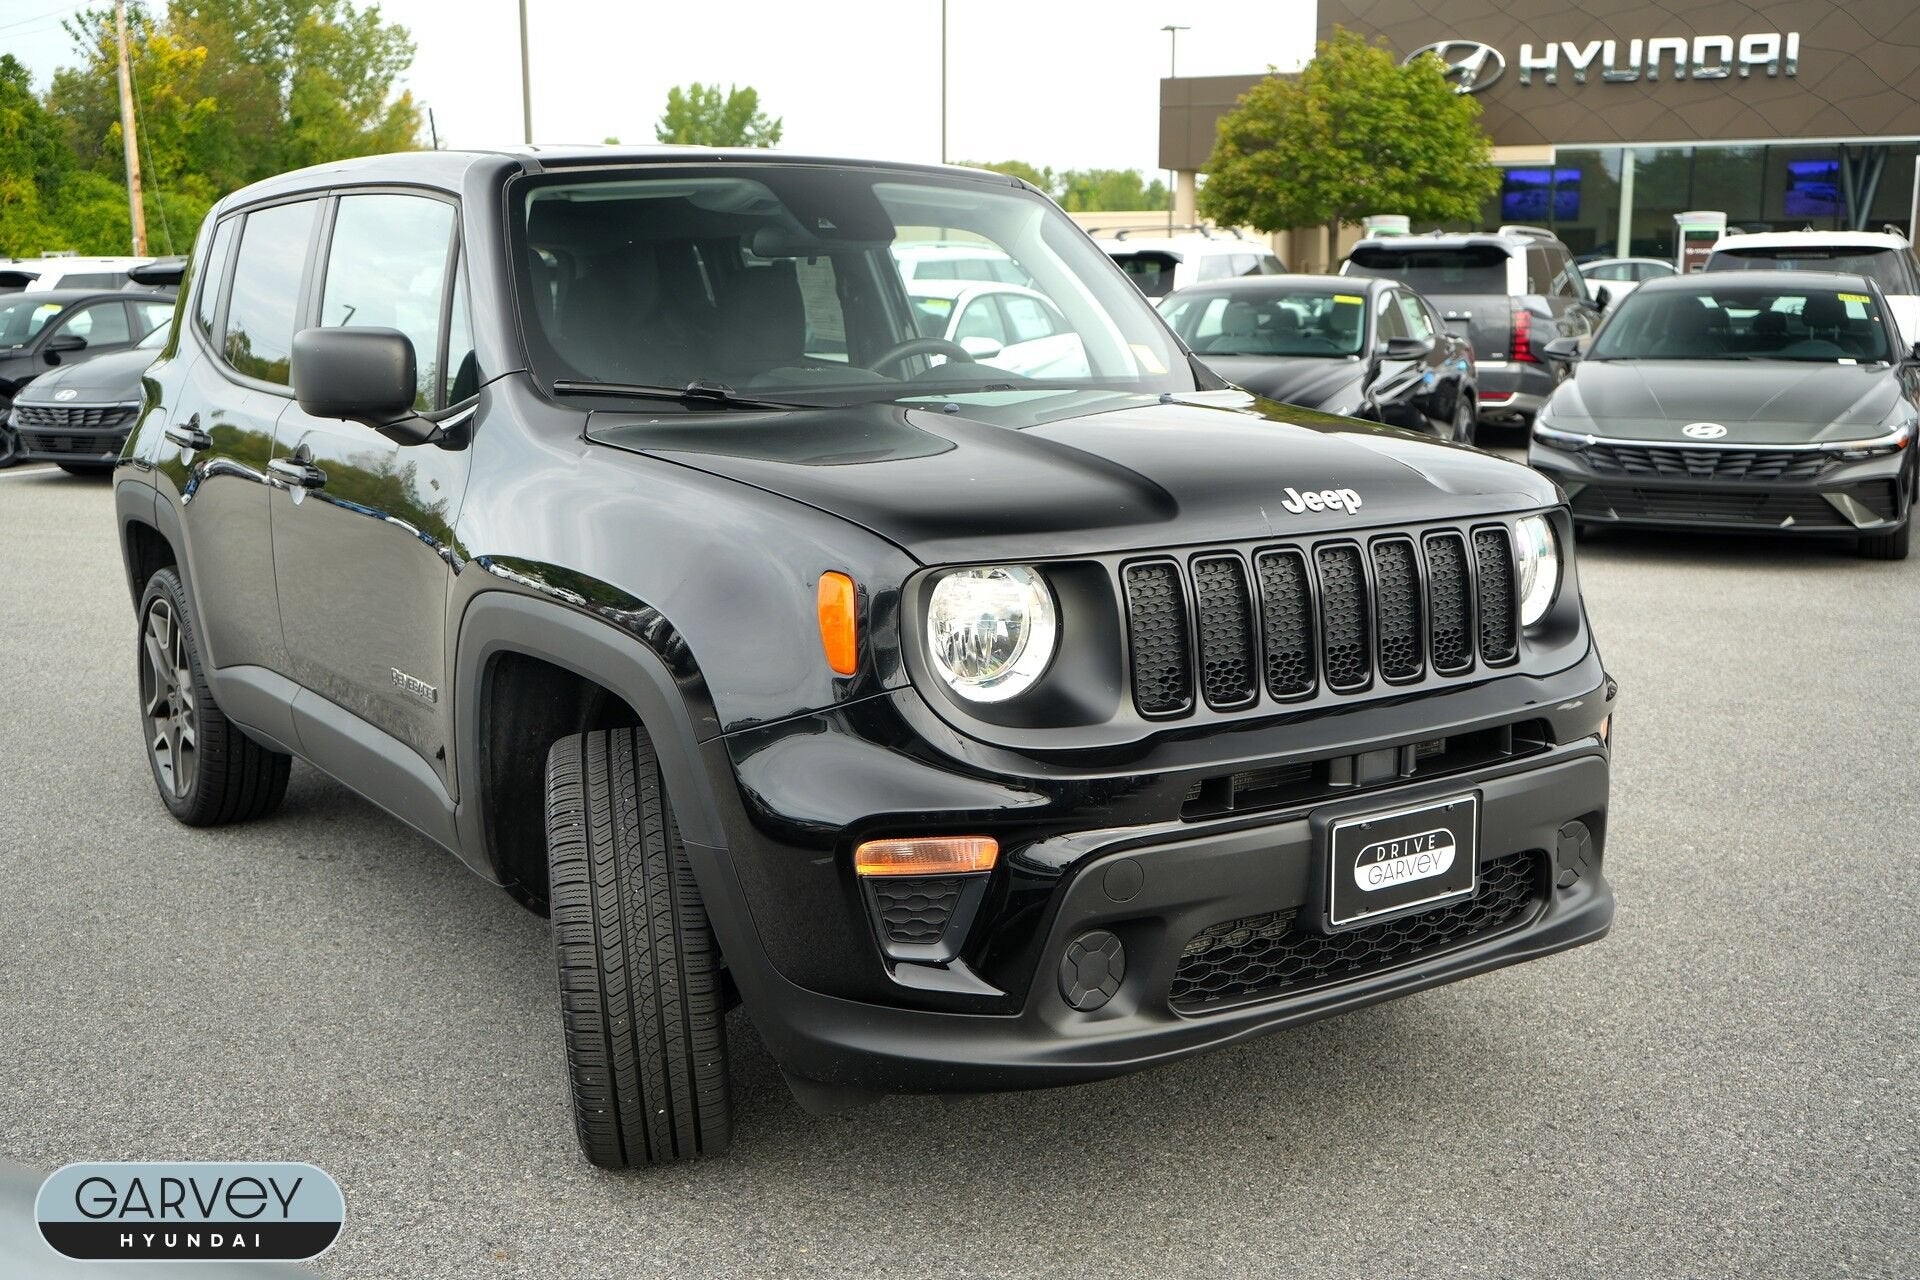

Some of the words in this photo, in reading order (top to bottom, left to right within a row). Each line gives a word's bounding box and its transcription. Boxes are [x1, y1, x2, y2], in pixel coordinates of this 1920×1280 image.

[1518, 31, 1801, 86] HYUNDAI
[1282, 486, 1363, 515] Jeep
[1377, 834, 1436, 861] DRIVE
